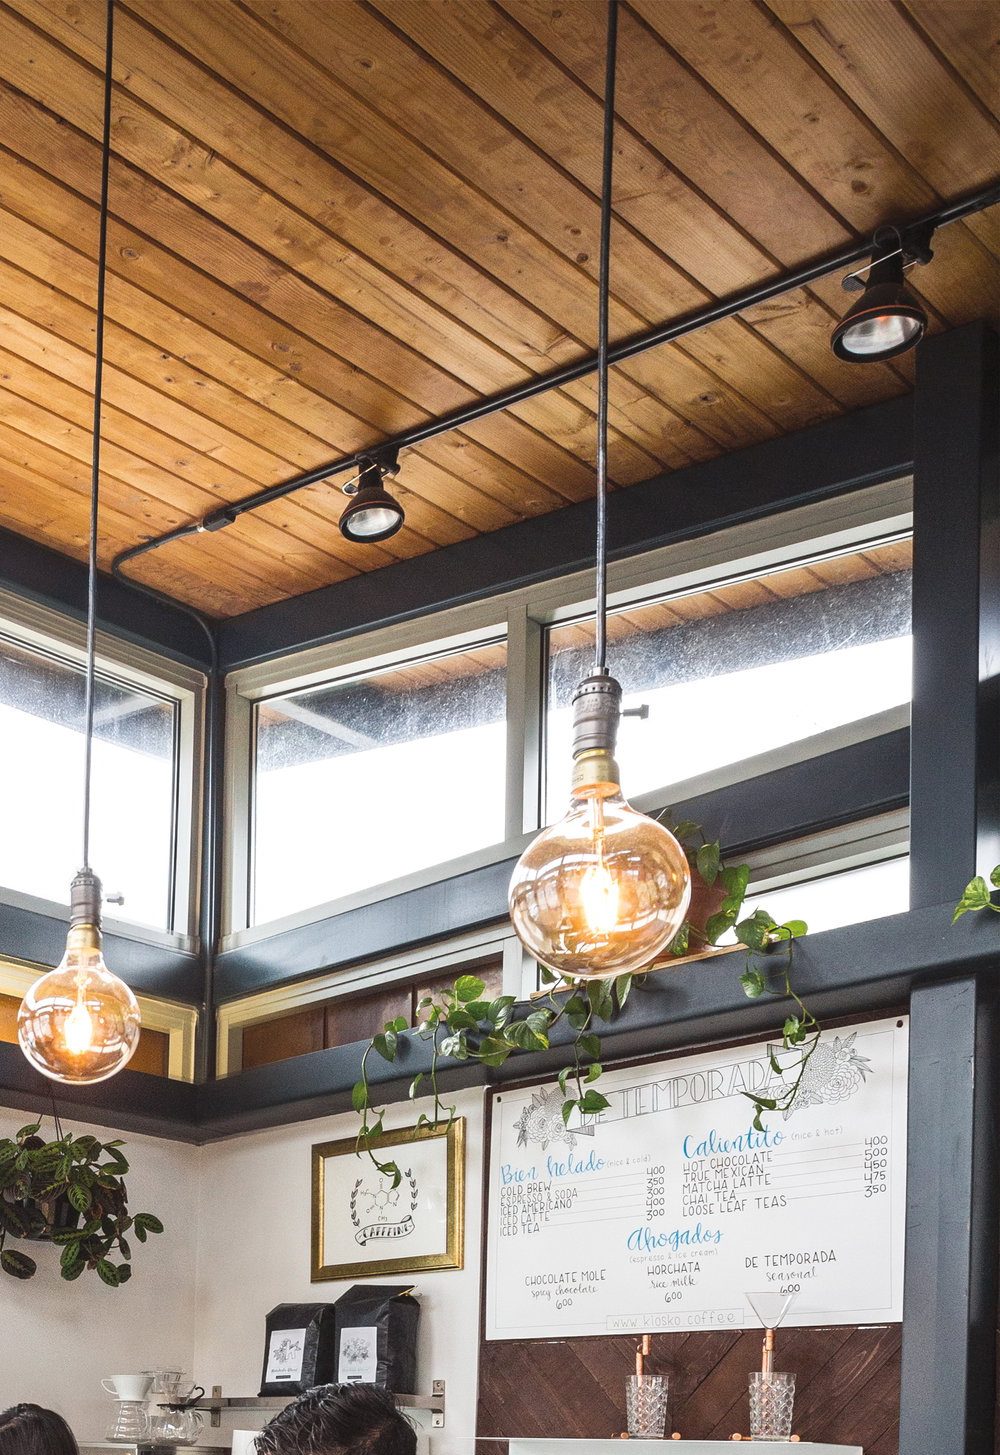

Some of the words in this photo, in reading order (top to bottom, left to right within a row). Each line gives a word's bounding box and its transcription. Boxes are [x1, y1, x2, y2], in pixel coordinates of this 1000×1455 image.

[618, 1056, 786, 1118] TEMPORADA
[683, 1124, 787, 1159] Calientito
[683, 1160, 706, 1172] HOT
[710, 1150, 773, 1170] CHOCOLATE
[864, 1135, 888, 1148] 400
[501, 1164, 538, 1185] Bien
[547, 1149, 605, 1177] helado
[683, 1170, 710, 1183] TRUE
[715, 1164, 764, 1179] MEXICAN
[864, 1147, 888, 1161] 500
[683, 1179, 728, 1194] MATCHA
[733, 1173, 771, 1189] LATTE
[864, 1159, 887, 1172] 450
[500, 1193, 543, 1208] ESPRESSO
[555, 1188, 578, 1200] SODA
[646, 1176, 664, 1188] 350
[501, 1184, 523, 1197] COLD
[527, 1181, 552, 1194] BREW
[646, 1165, 665, 1177] 400
[683, 1193, 708, 1206] CHAI
[714, 1190, 736, 1202] TEA
[864, 1170, 886, 1184] 475
[500, 1204, 518, 1216] ICED
[522, 1199, 572, 1213] AMERICANO
[646, 1187, 664, 1200] 300
[500, 1215, 518, 1225] ICED
[521, 1211, 550, 1225] LATTE
[646, 1197, 665, 1209] 400
[683, 1203, 714, 1217] LOOSE
[720, 1199, 747, 1213] LEAF
[755, 1194, 787, 1208] TEAS
[864, 1183, 887, 1198] 350
[500, 1225, 518, 1237] ICED
[522, 1222, 540, 1234] TEA
[646, 1208, 665, 1221] 300
[627, 1222, 724, 1252] Ahogados
[647, 1261, 701, 1276] HORCHATA
[745, 1256, 758, 1268] DE
[764, 1249, 836, 1267] TEMPORADA
[525, 1271, 577, 1286] CHOCOLATE
[581, 1269, 606, 1281] MOLE
[650, 1279, 667, 1288] rice
[671, 1274, 696, 1287] milk
[766, 1266, 817, 1282] seasonal
[531, 1289, 551, 1301] spicy
[555, 1283, 598, 1296] chocolate
[556, 1298, 573, 1309] 600
[664, 1291, 682, 1303] 600
[780, 1284, 800, 1296] 600
